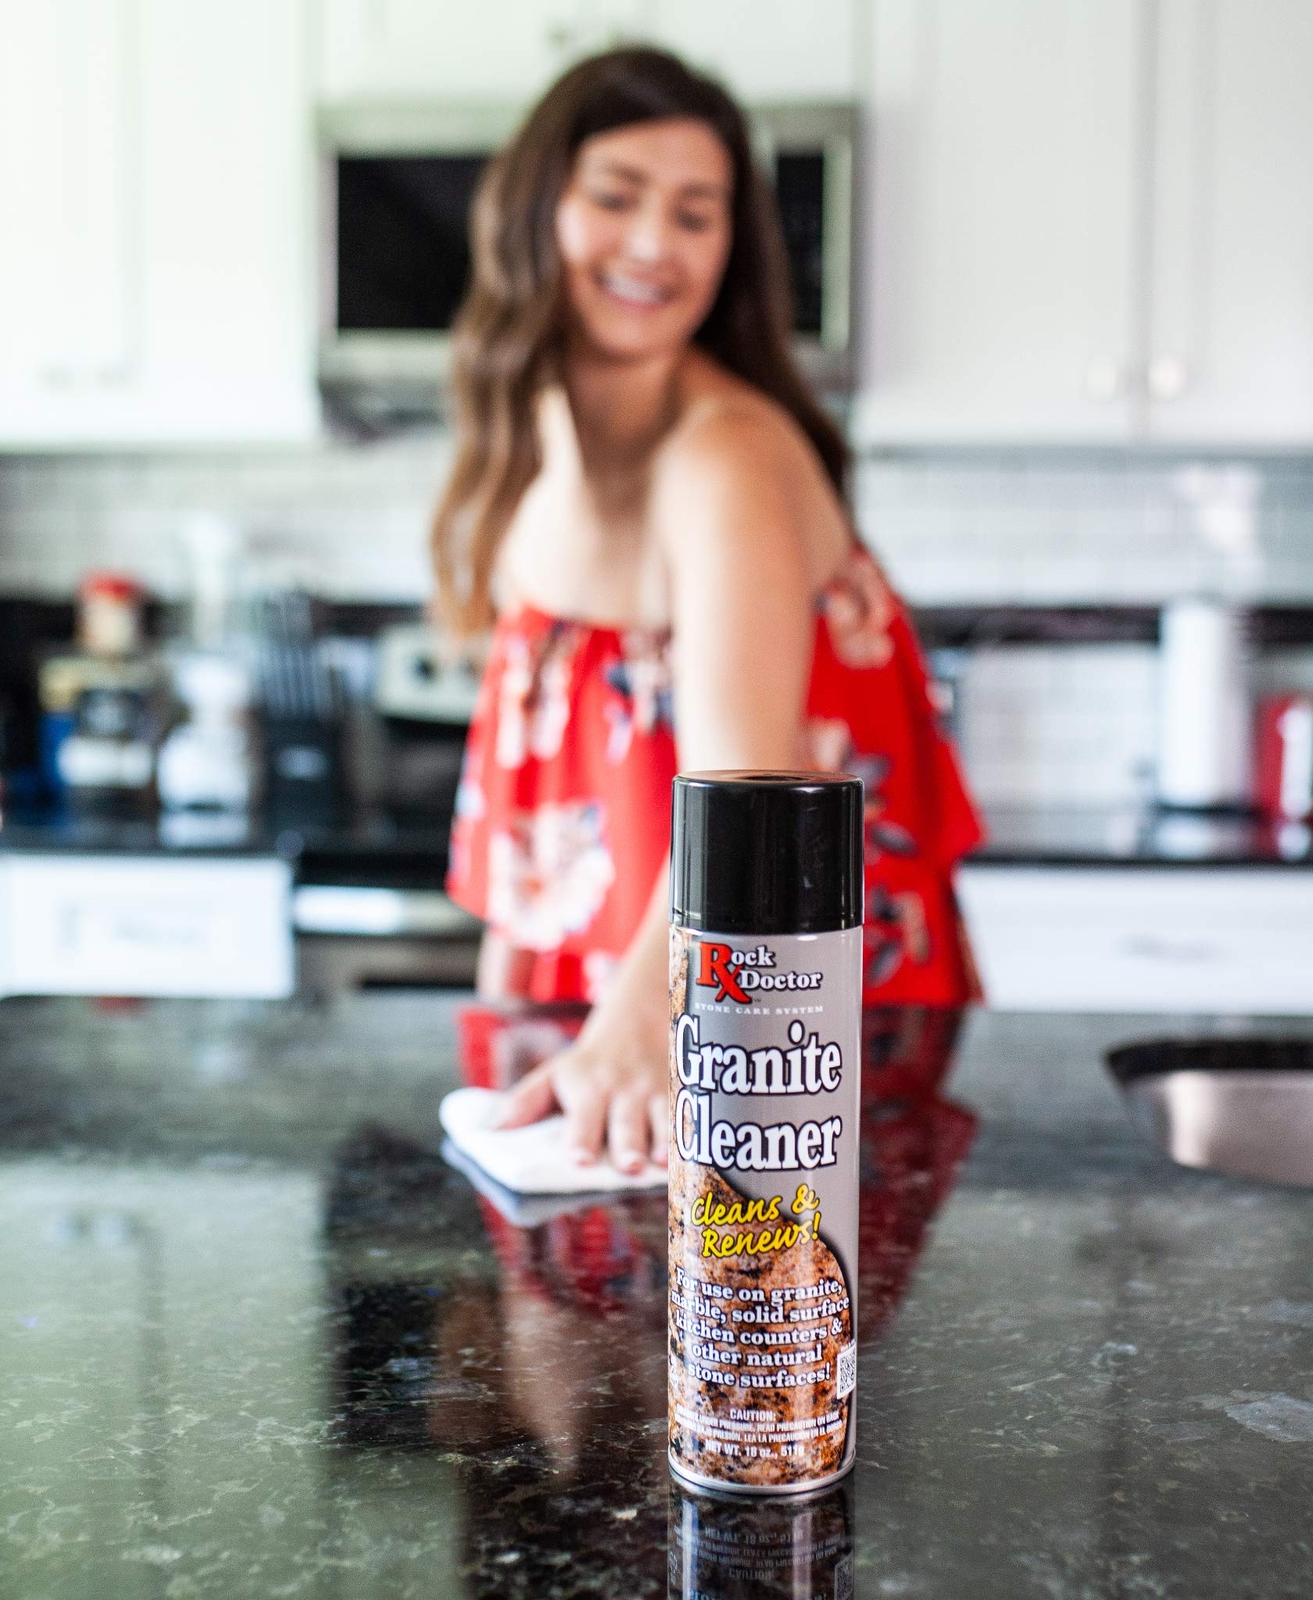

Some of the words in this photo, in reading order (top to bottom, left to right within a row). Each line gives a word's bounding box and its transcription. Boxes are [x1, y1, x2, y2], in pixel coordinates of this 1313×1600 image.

[739, 970, 823, 991] Doctor
[695, 1002, 730, 1013] STONE
[735, 1007, 770, 1015] CARE
[776, 1005, 823, 1015] SYSTEM
[676, 1013, 842, 1094] Granite
[676, 1087, 842, 1171] Cleaner
[691, 1191, 782, 1226] Cleans
[791, 1183, 820, 1214] &
[701, 1212, 821, 1258] Renews!
[676, 1267, 698, 1291] For
[700, 1282, 733, 1299] use
[738, 1288, 766, 1302] on
[770, 1277, 843, 1308] granite,
[671, 1290, 726, 1324] marble,
[732, 1304, 785, 1324] solid
[789, 1296, 850, 1323] surface
[675, 1309, 735, 1343] kitchen
[739, 1325, 828, 1346] counters
[830, 1317, 843, 1336] &
[692, 1342, 741, 1365] other
[746, 1343, 823, 1367] natural
[687, 1362, 736, 1386] stone
[739, 1362, 831, 1388] surfaces!
[730, 1408, 776, 1422] CAUTION:
[705, 1439, 722, 1453] NET
[724, 1443, 741, 1456] WT.
[745, 1446, 757, 1457] 18
